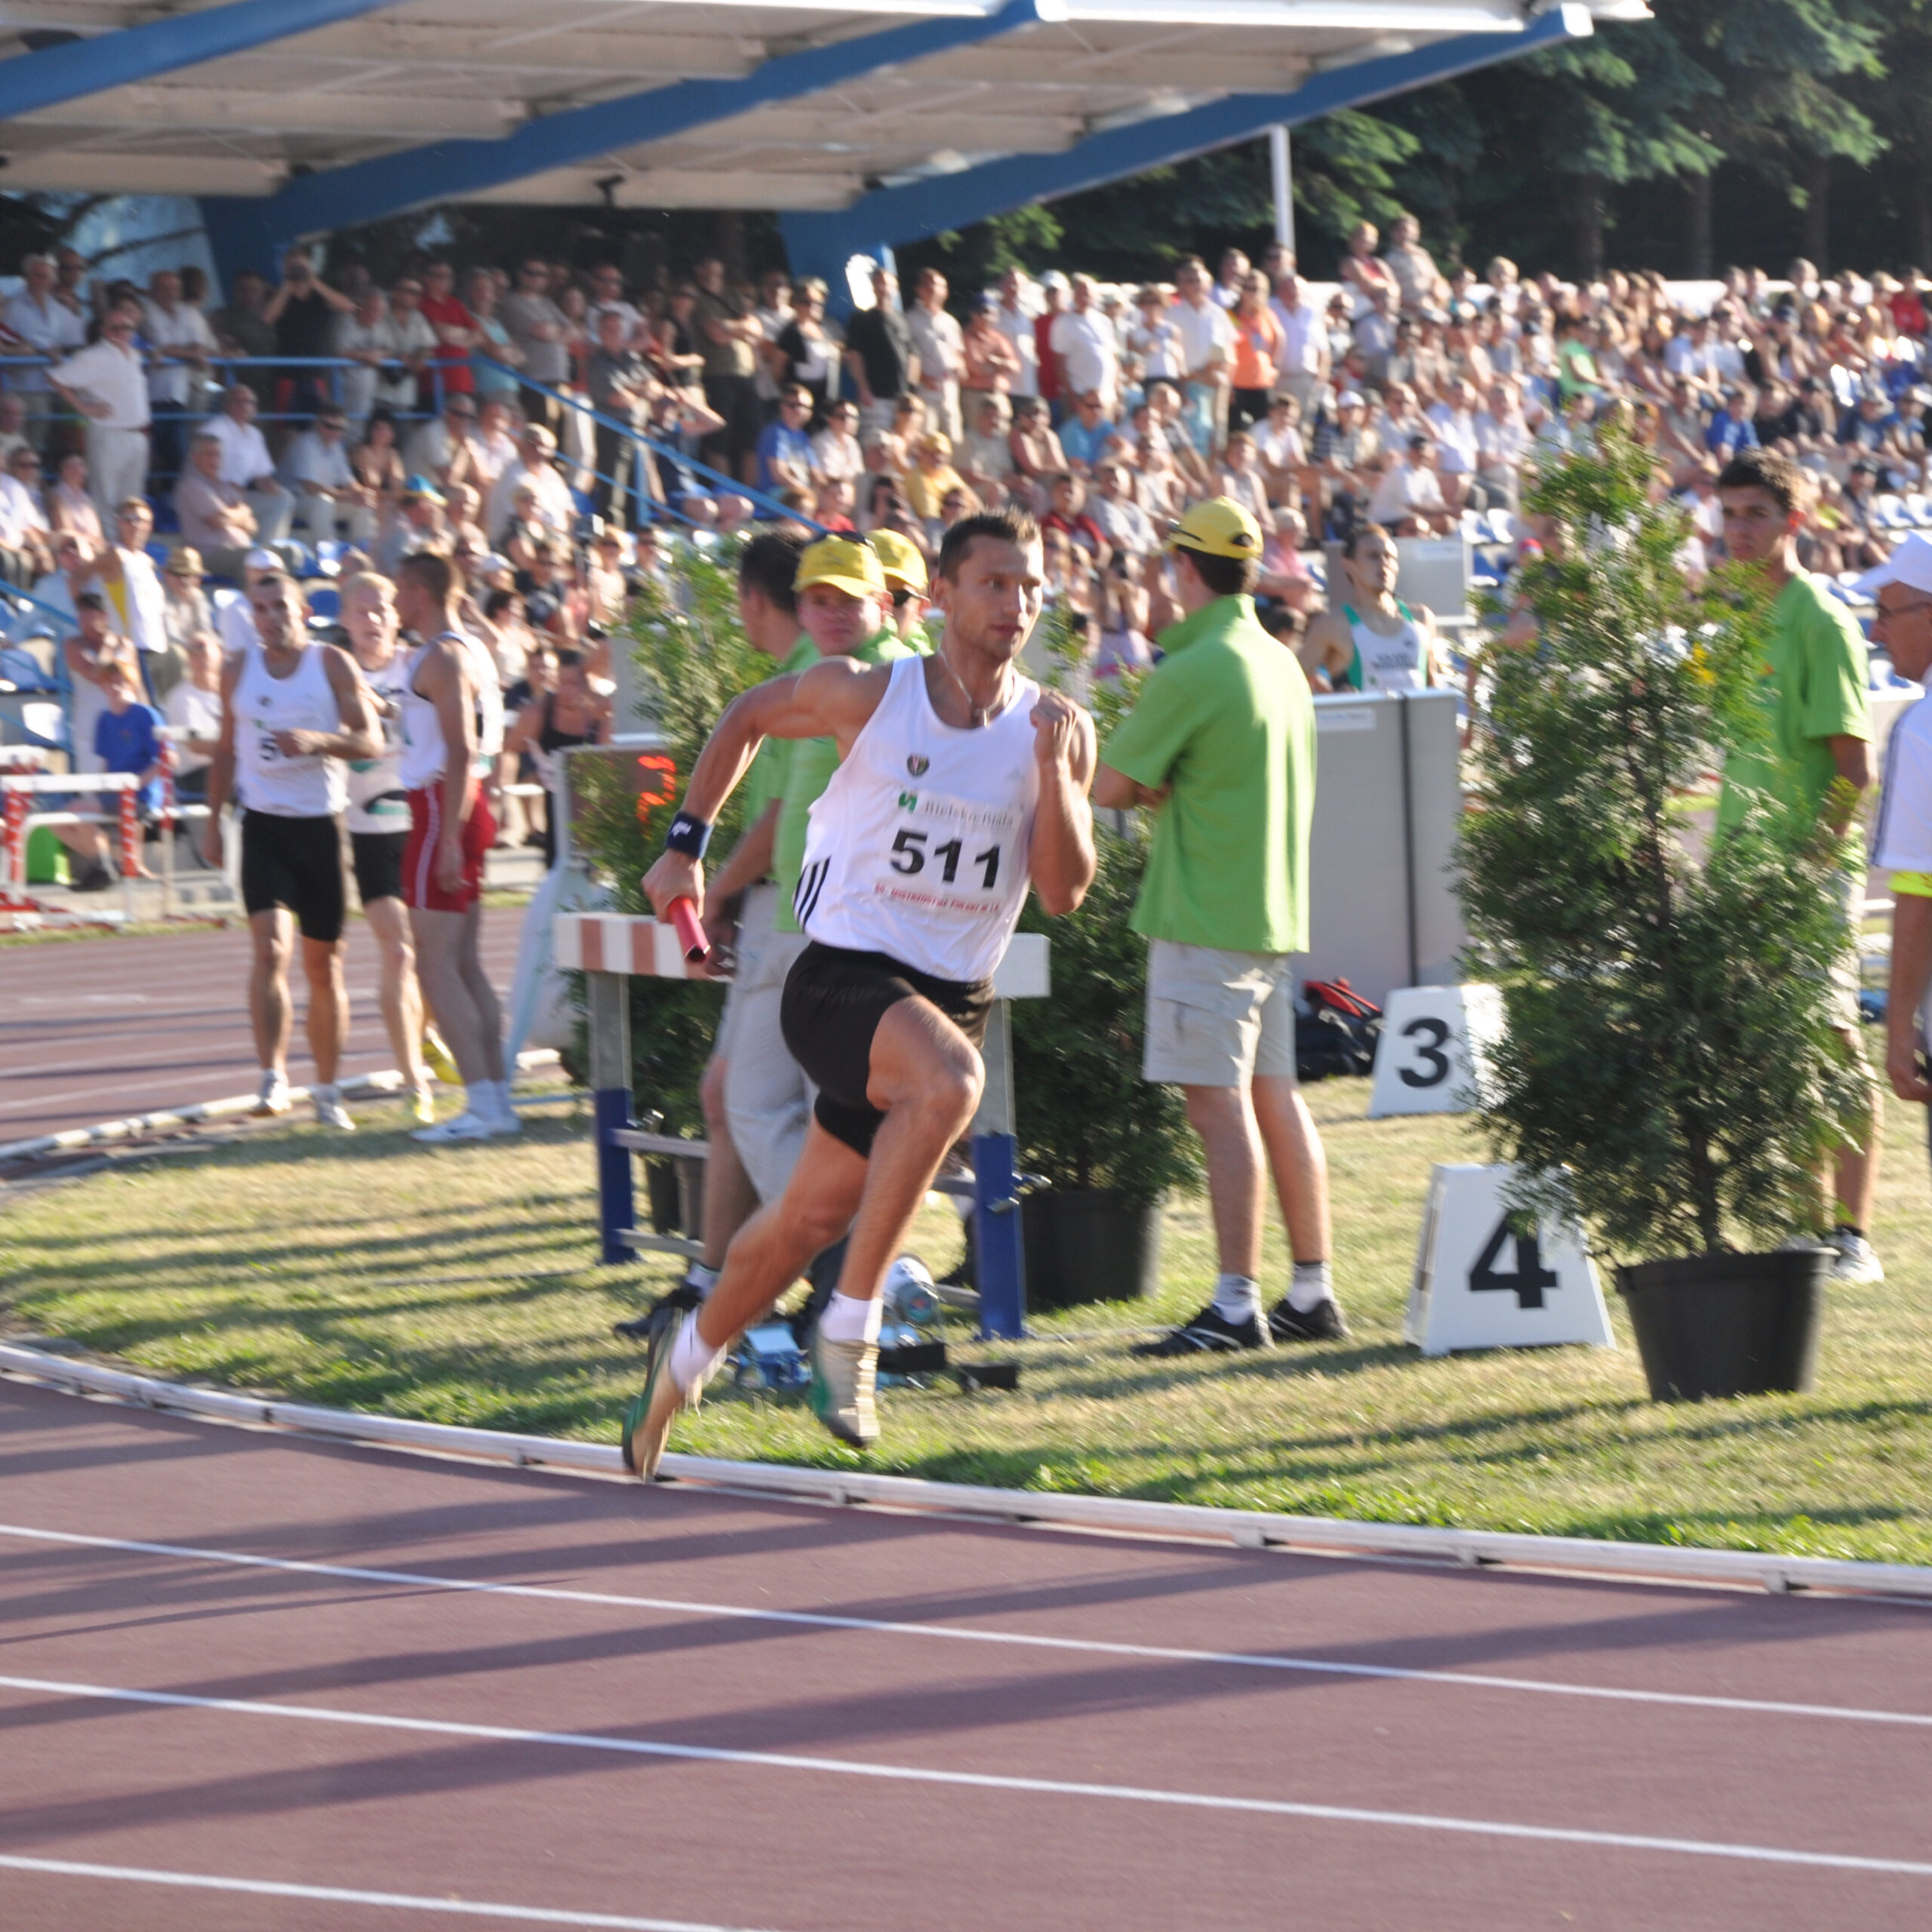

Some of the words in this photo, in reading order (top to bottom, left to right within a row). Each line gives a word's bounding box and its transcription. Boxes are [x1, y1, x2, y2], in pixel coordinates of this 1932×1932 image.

[890, 827, 1001, 890] 511
[1396, 1017, 1450, 1088] 3
[1469, 1207, 1560, 1309] 4
